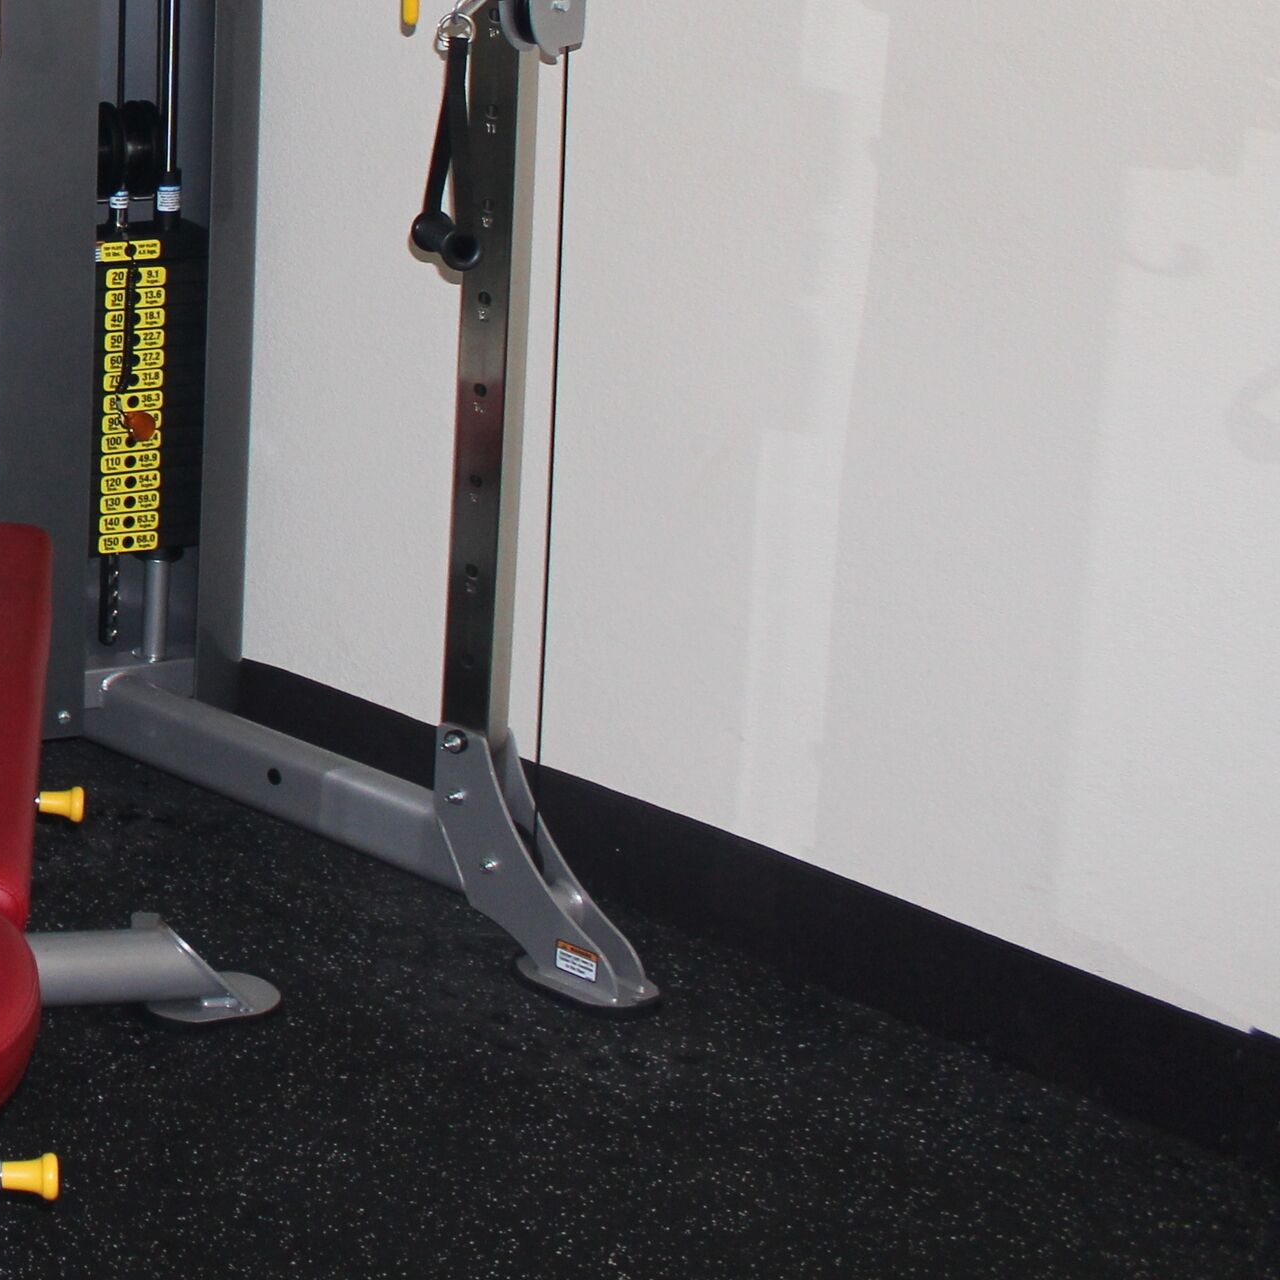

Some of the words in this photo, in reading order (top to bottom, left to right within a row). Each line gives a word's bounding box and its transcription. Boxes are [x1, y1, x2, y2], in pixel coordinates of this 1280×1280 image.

[111, 271, 125, 281] 20
[146, 270, 159, 279] 9.1
[111, 292, 124, 302] 30
[144, 290, 162, 299] 13.6
[110, 314, 123, 323] 40
[144, 311, 160, 320] 18.1
[110, 335, 123, 345] 50
[142, 332, 161, 340] 22.7
[110, 355, 122, 365] 60
[142, 352, 160, 362] 27.2
[109, 375, 121, 384] 70
[142, 372, 160, 381] 31.8
[141, 393, 160, 403] 36.3
[108, 417, 120, 427] 90
[106, 436, 122, 446] 100
[104, 457, 121, 467] 110
[139, 453, 158, 462] 49.9
[105, 477, 121, 488] 120
[138, 474, 157, 483] 54.4
[105, 497, 121, 507] 130
[138, 494, 157, 503] 59.0
[104, 517, 120, 527] 140
[137, 514, 156, 523] 63.5
[103, 537, 119, 547] 150
[136, 534, 156, 544] 68.0
